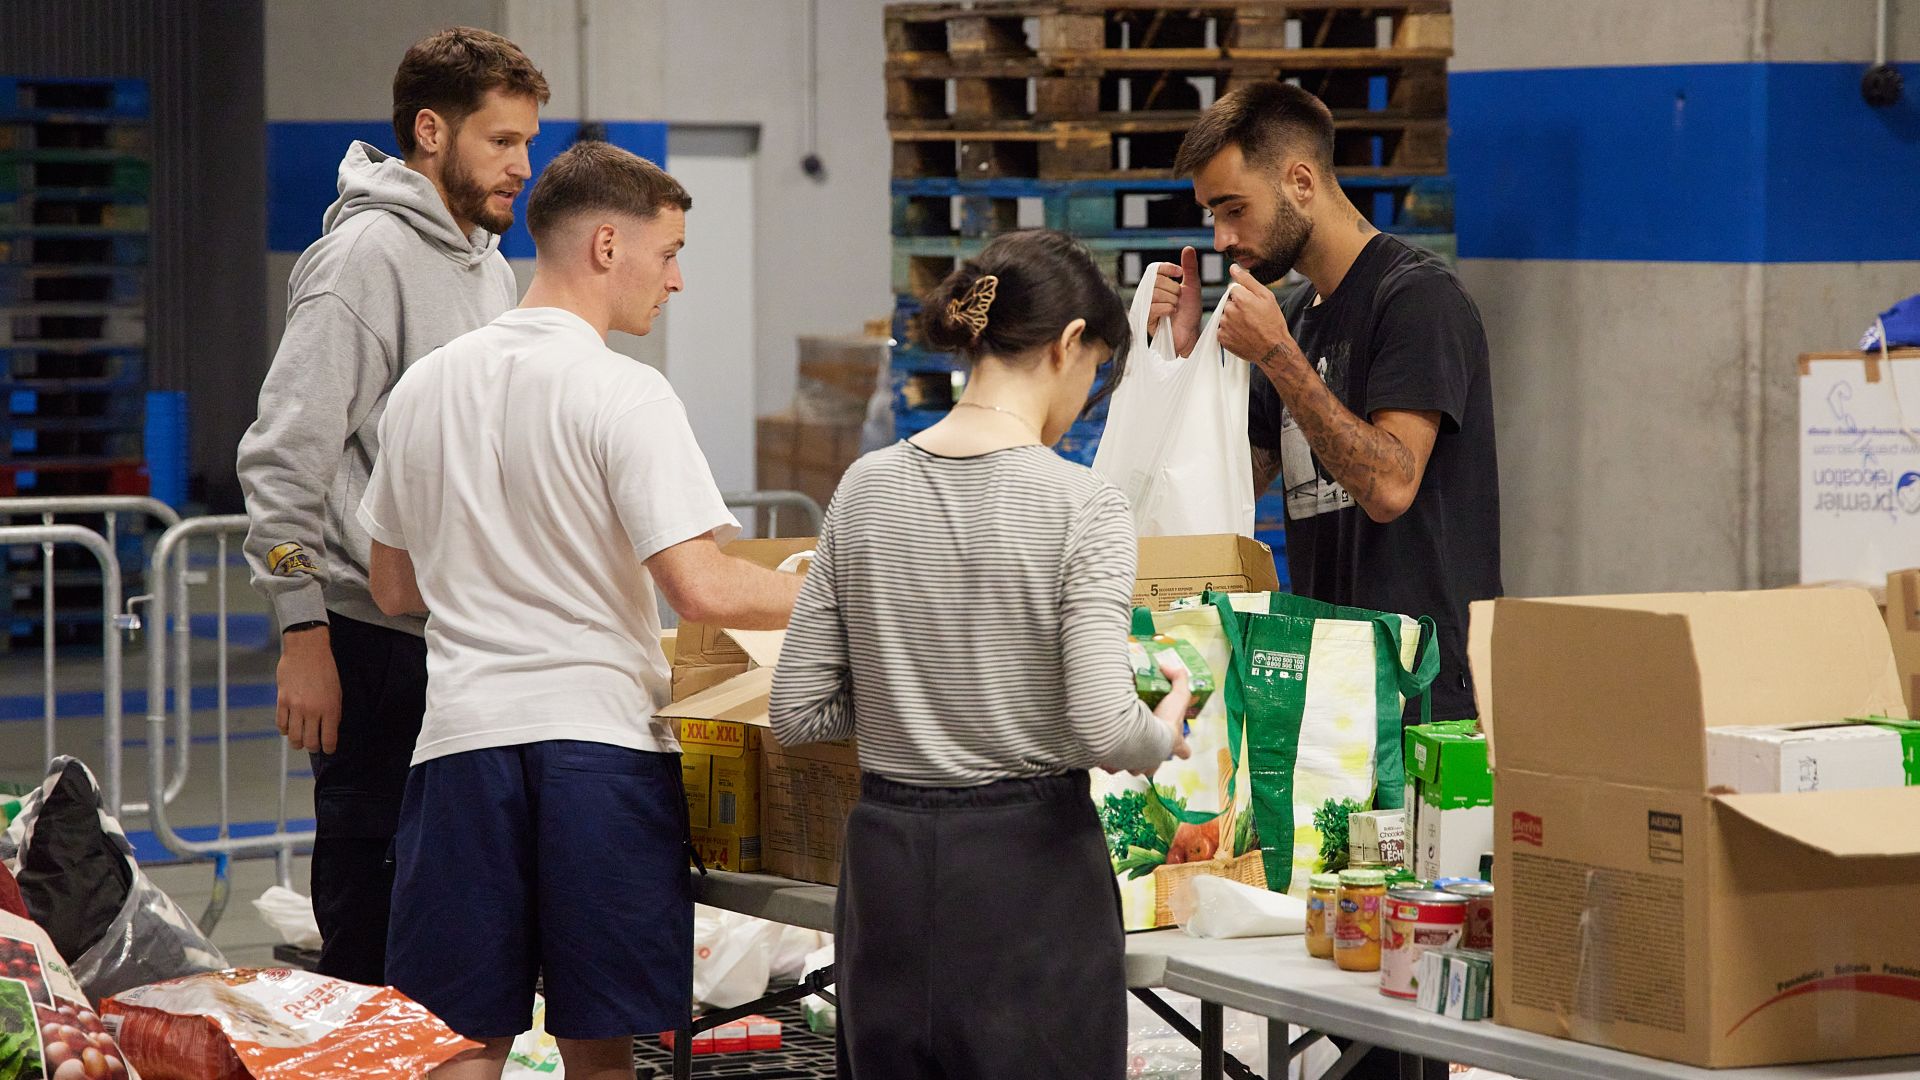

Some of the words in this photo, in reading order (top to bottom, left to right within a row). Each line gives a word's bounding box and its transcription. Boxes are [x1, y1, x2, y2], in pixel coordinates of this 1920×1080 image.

[1814, 468, 1894, 488] relocation
[1814, 490, 1895, 517] premier
[1150, 583, 1158, 596] 5
[687, 722, 710, 740] XXL
[716, 725, 740, 743] XXL
[1379, 830, 1405, 839] Chocolat
[1380, 842, 1398, 851] 90%
[1381, 851, 1405, 862] LECH
